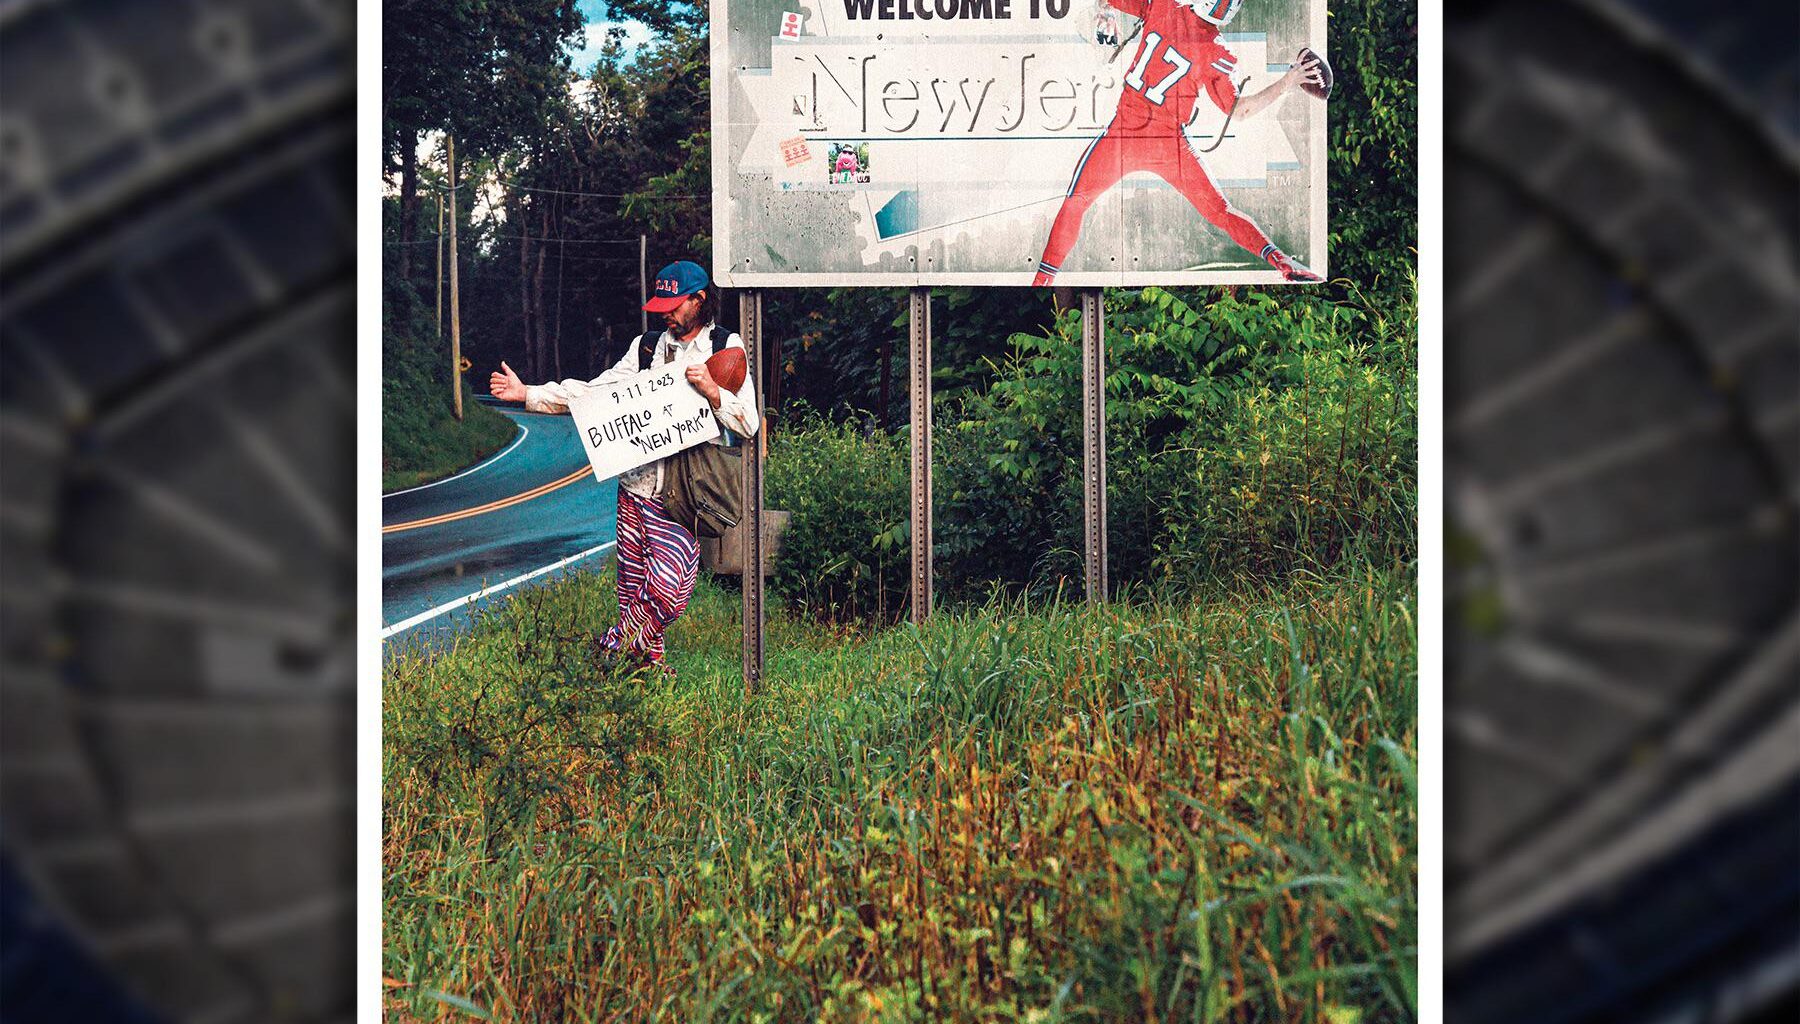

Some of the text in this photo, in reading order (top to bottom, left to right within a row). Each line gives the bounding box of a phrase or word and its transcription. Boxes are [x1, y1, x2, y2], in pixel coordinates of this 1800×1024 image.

[843, 0, 1071, 20] WELCOME TO
[794, 54, 995, 132] New
[1124, 31, 1192, 106] 17
[587, 403, 674, 448] BUFFALO AT
